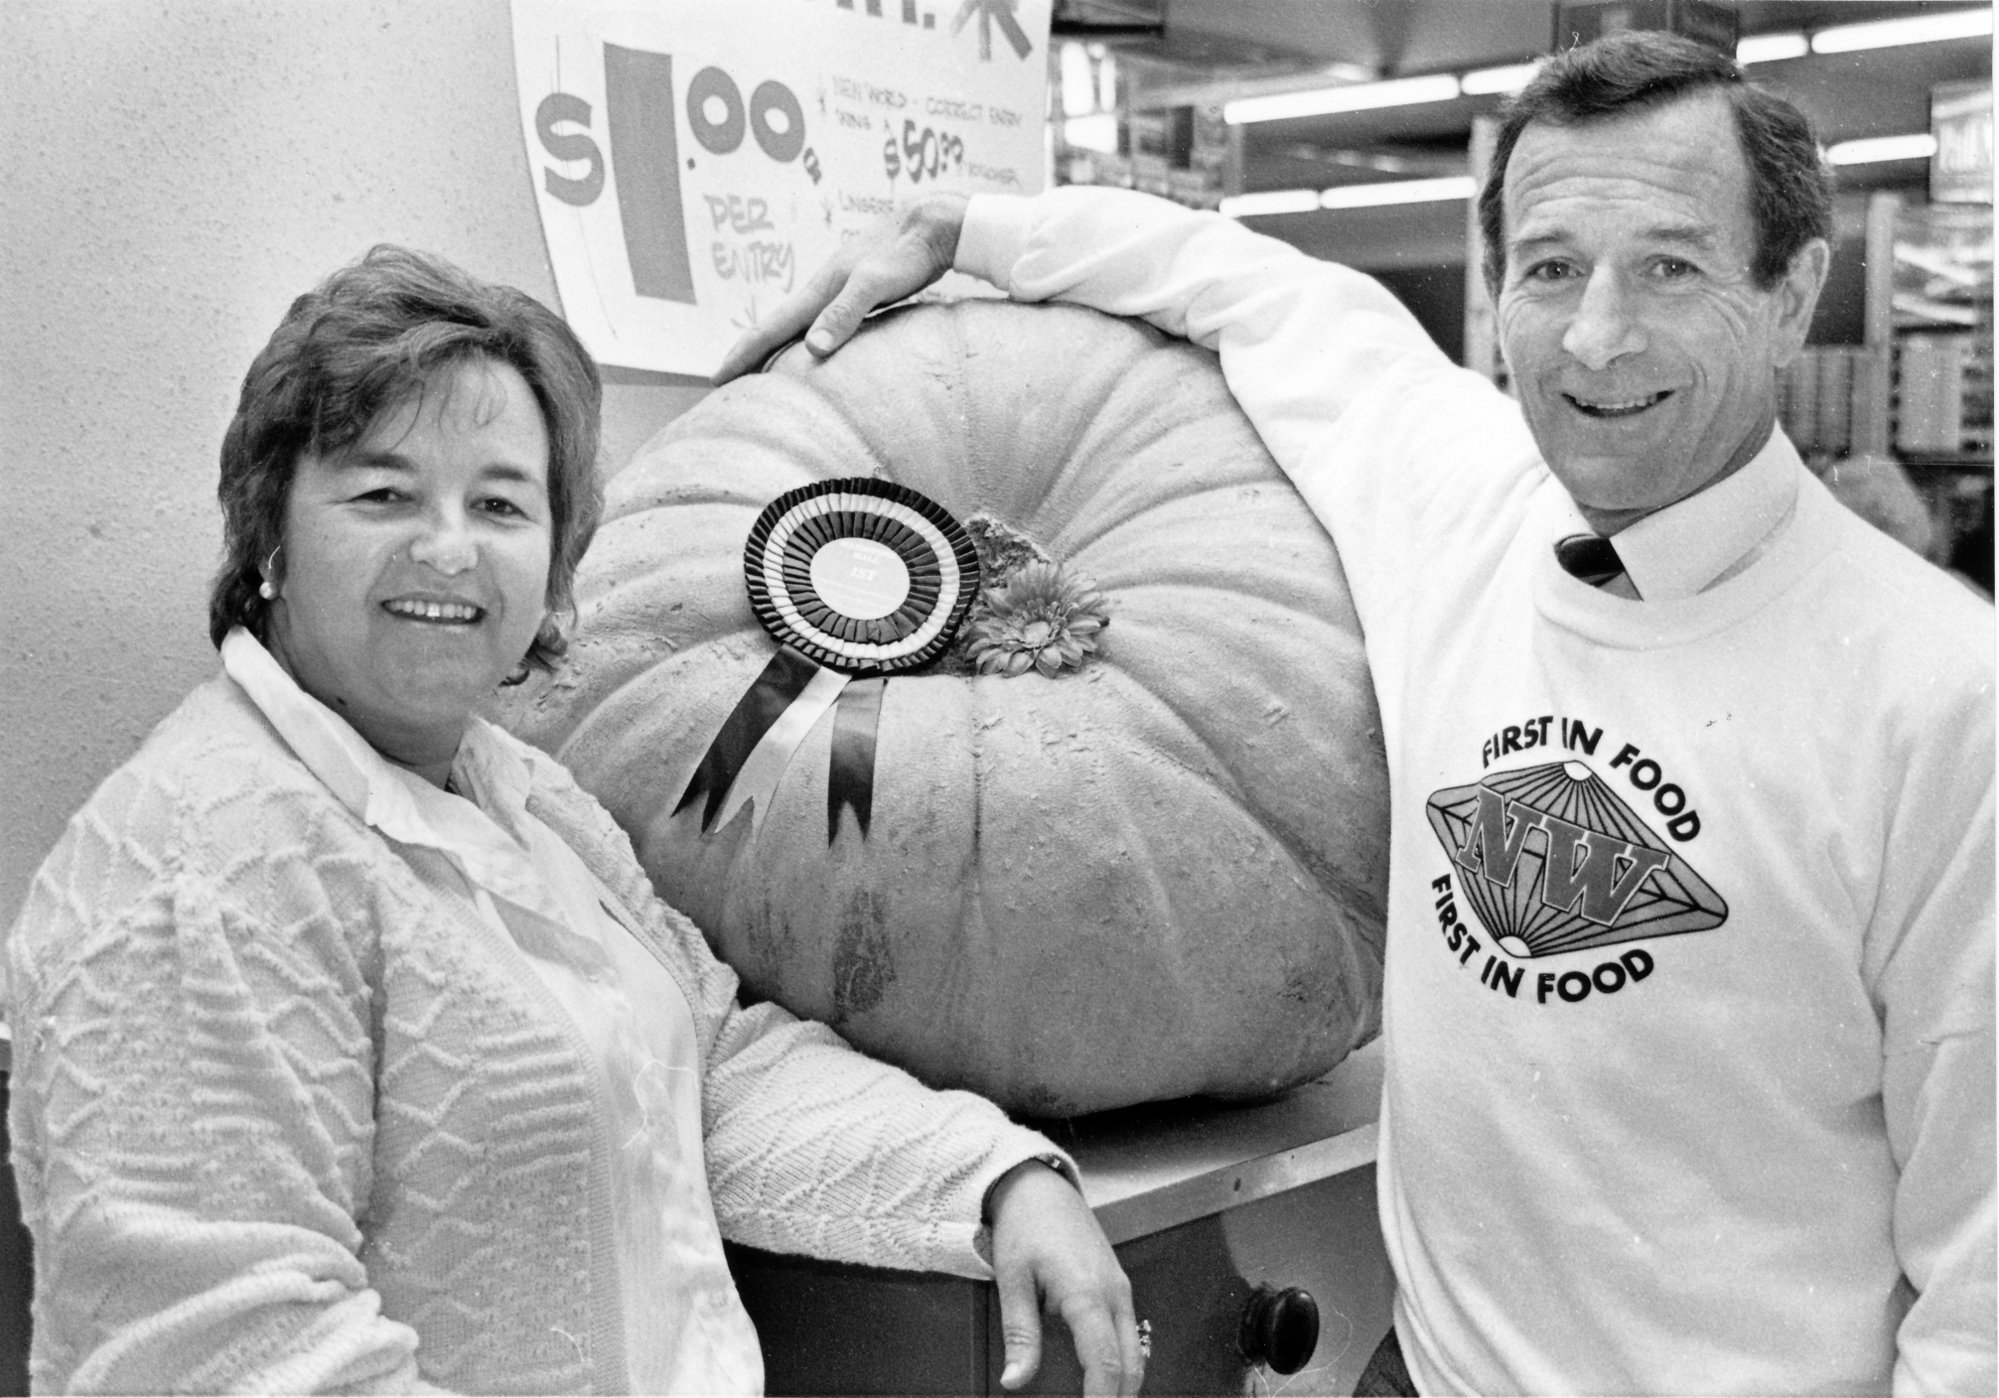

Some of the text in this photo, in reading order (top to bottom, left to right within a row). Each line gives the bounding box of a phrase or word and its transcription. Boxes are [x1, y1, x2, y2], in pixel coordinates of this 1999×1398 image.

[704, 195, 774, 234] PER
[712, 242, 795, 294] ENTRY
[1482, 716, 1700, 842] FIRST IN FOOD
[1455, 783, 1671, 928] NW
[1431, 873, 1654, 1004] FIRST IN FOOD
